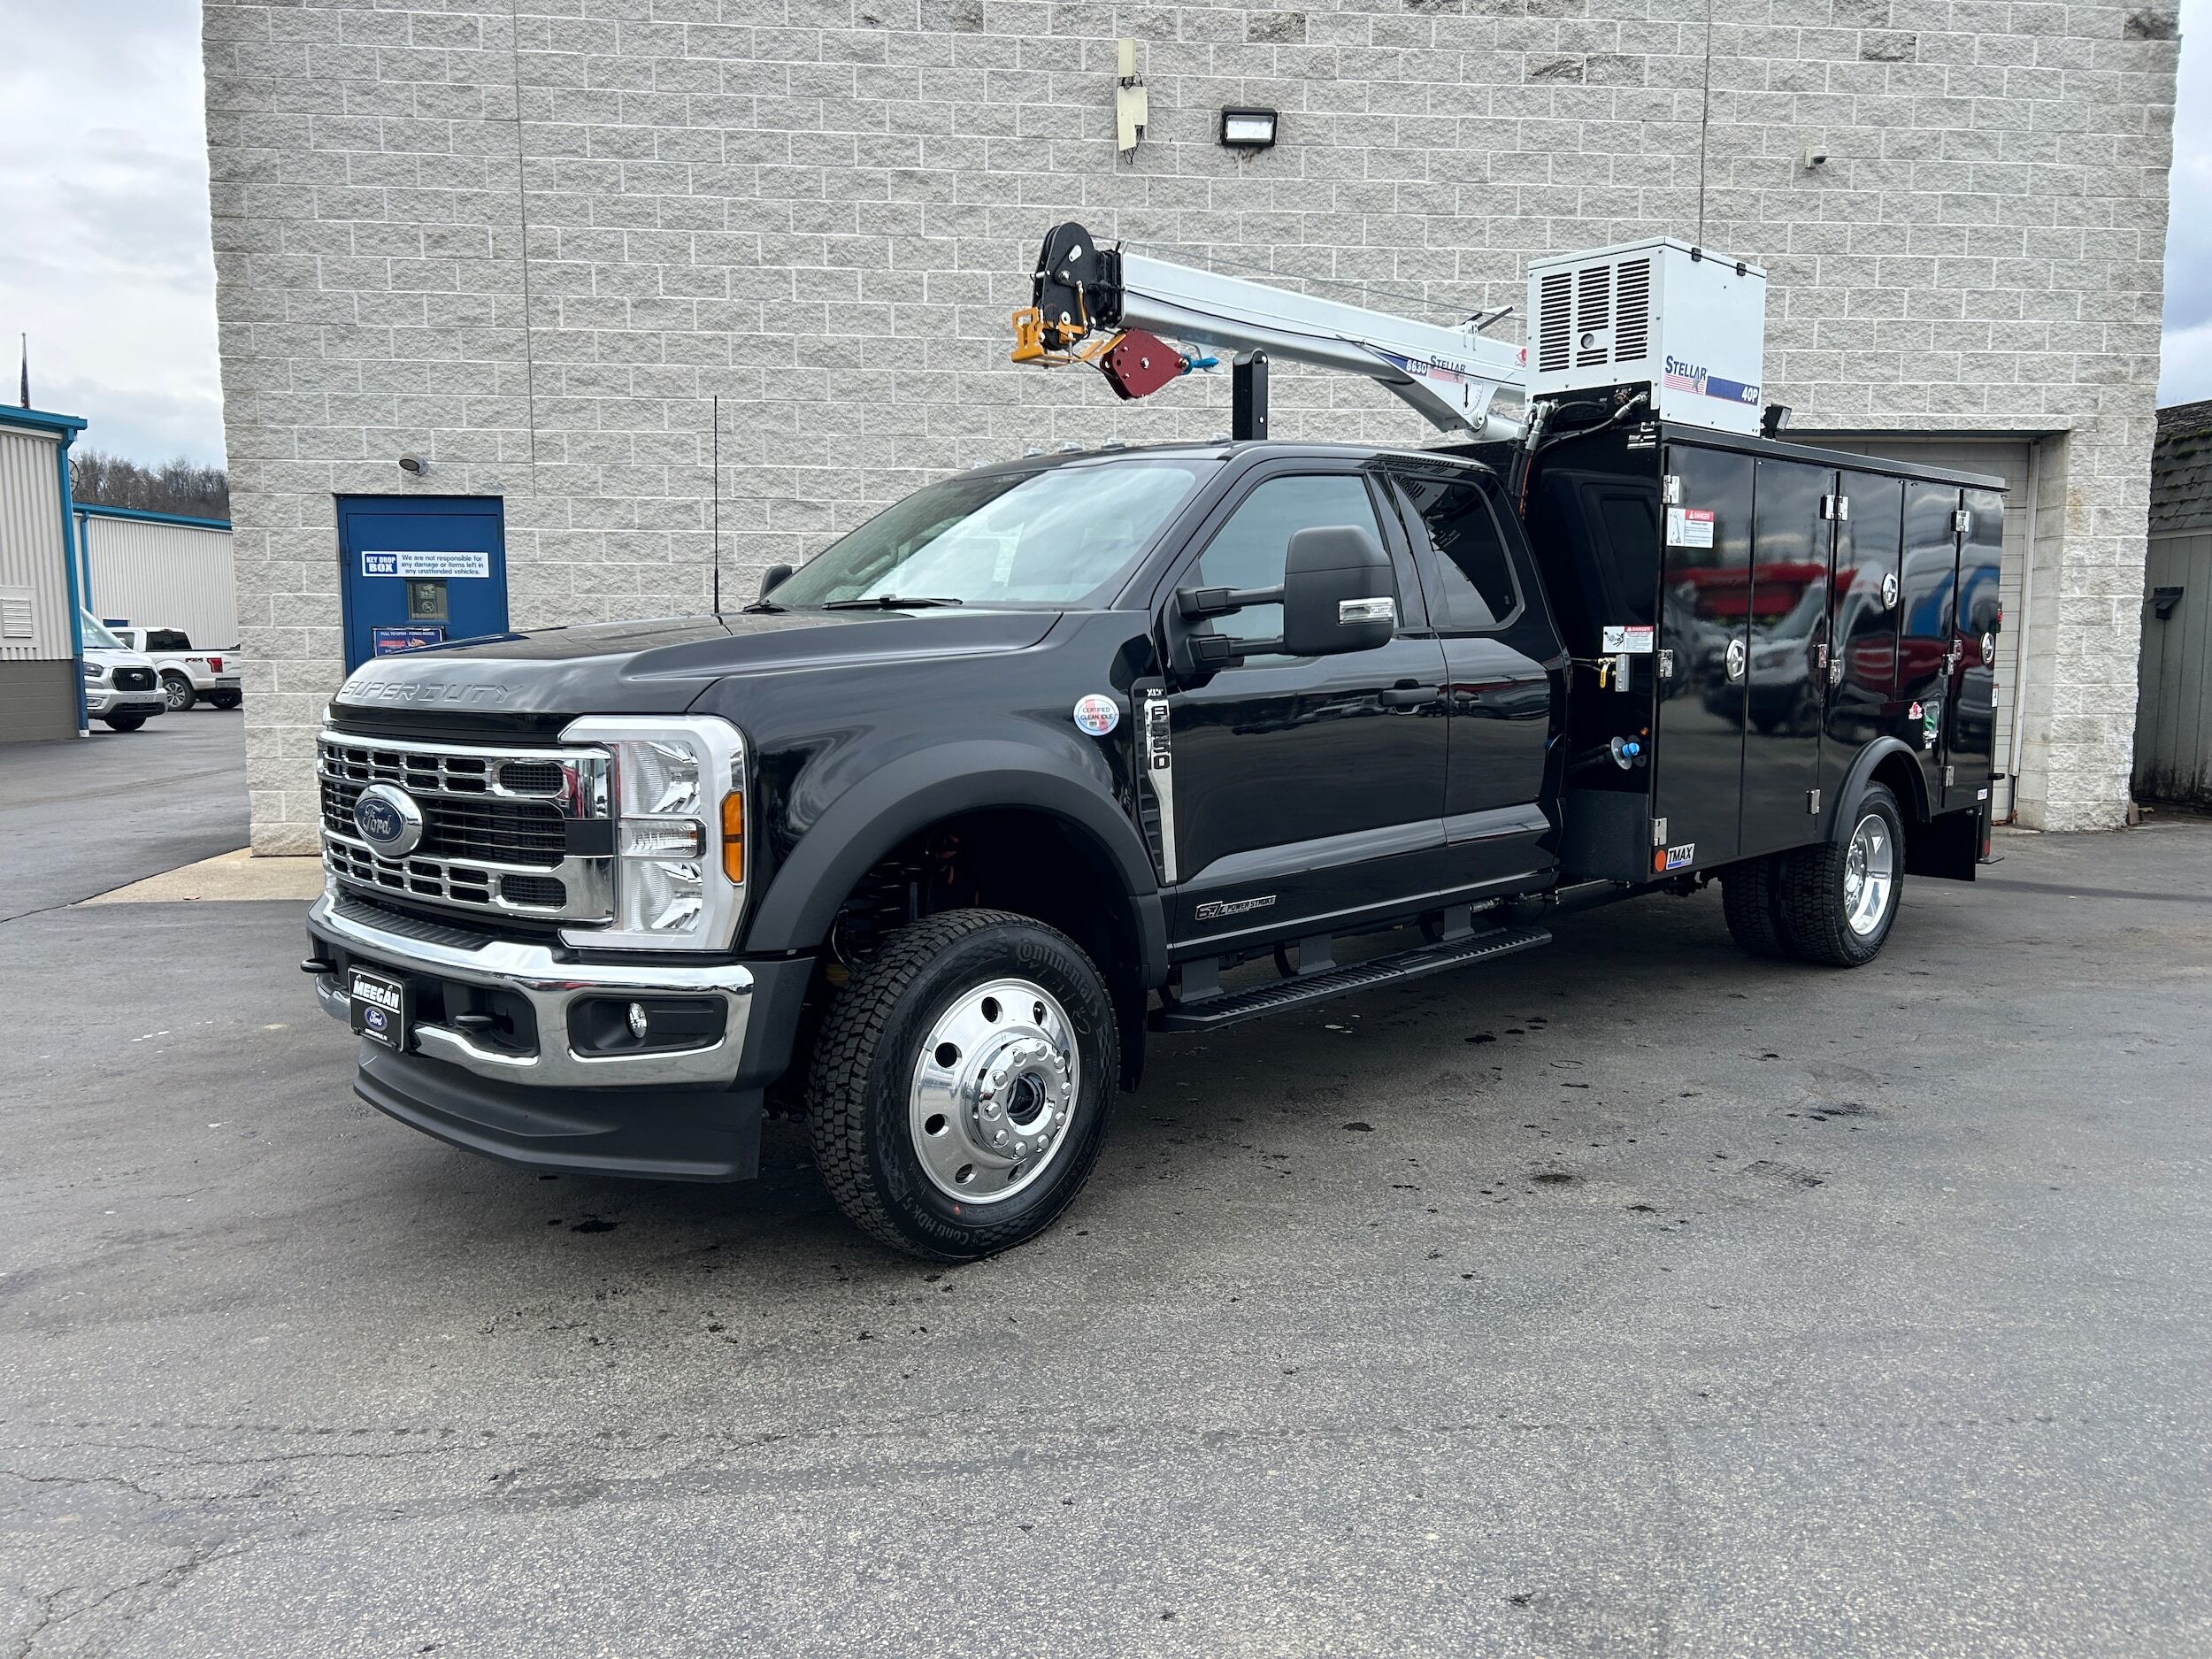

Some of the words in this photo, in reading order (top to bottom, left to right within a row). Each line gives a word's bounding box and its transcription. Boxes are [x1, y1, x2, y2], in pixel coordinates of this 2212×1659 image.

[1406, 358, 1427, 374] 8630
[1741, 386, 1759, 403] 40P
[368, 563, 394, 572] BOX
[340, 680, 420, 701] SUPER
[418, 683, 524, 703] DUTY
[362, 803, 392, 836] Ford
[1669, 846, 1693, 864] TMAX
[1015, 938, 1095, 1005] Continental
[353, 979, 400, 1010] MEEGAN
[369, 1010, 383, 1026] Ford
[934, 1224, 970, 1245] Conti
